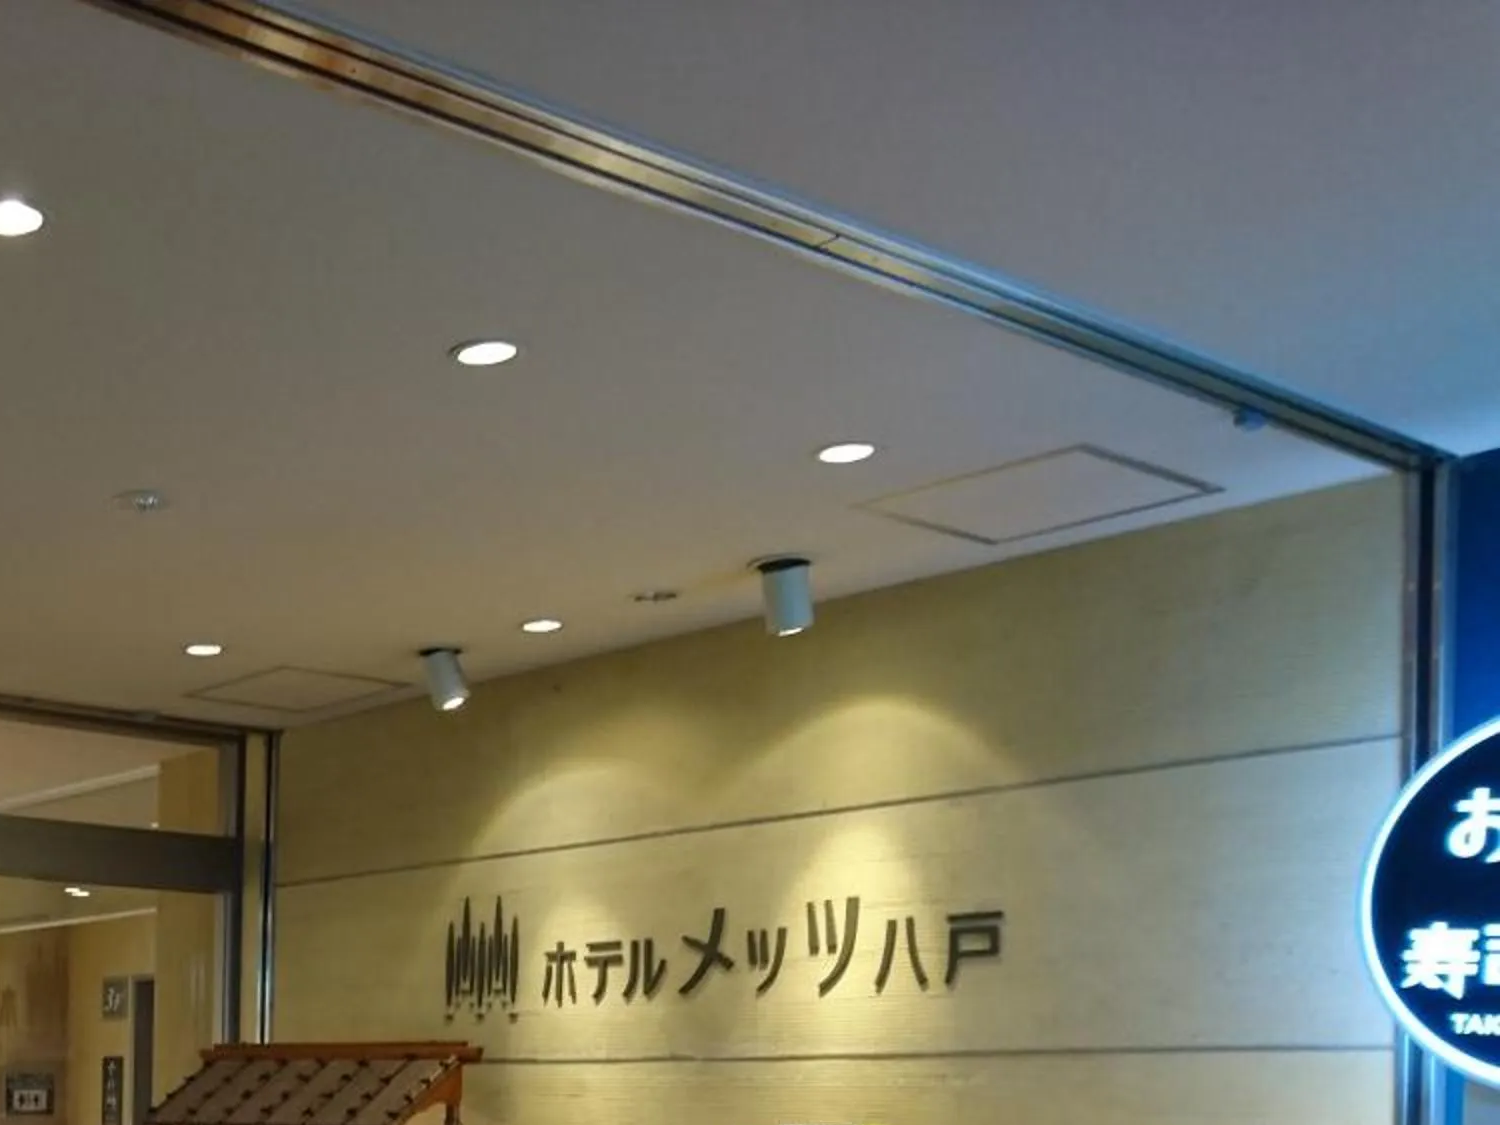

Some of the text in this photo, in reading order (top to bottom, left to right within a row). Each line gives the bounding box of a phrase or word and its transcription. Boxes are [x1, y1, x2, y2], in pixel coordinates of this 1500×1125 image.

[541, 895, 1004, 1009] ホテルメッツ八戸
[1401, 921, 1500, 1001] 寿
